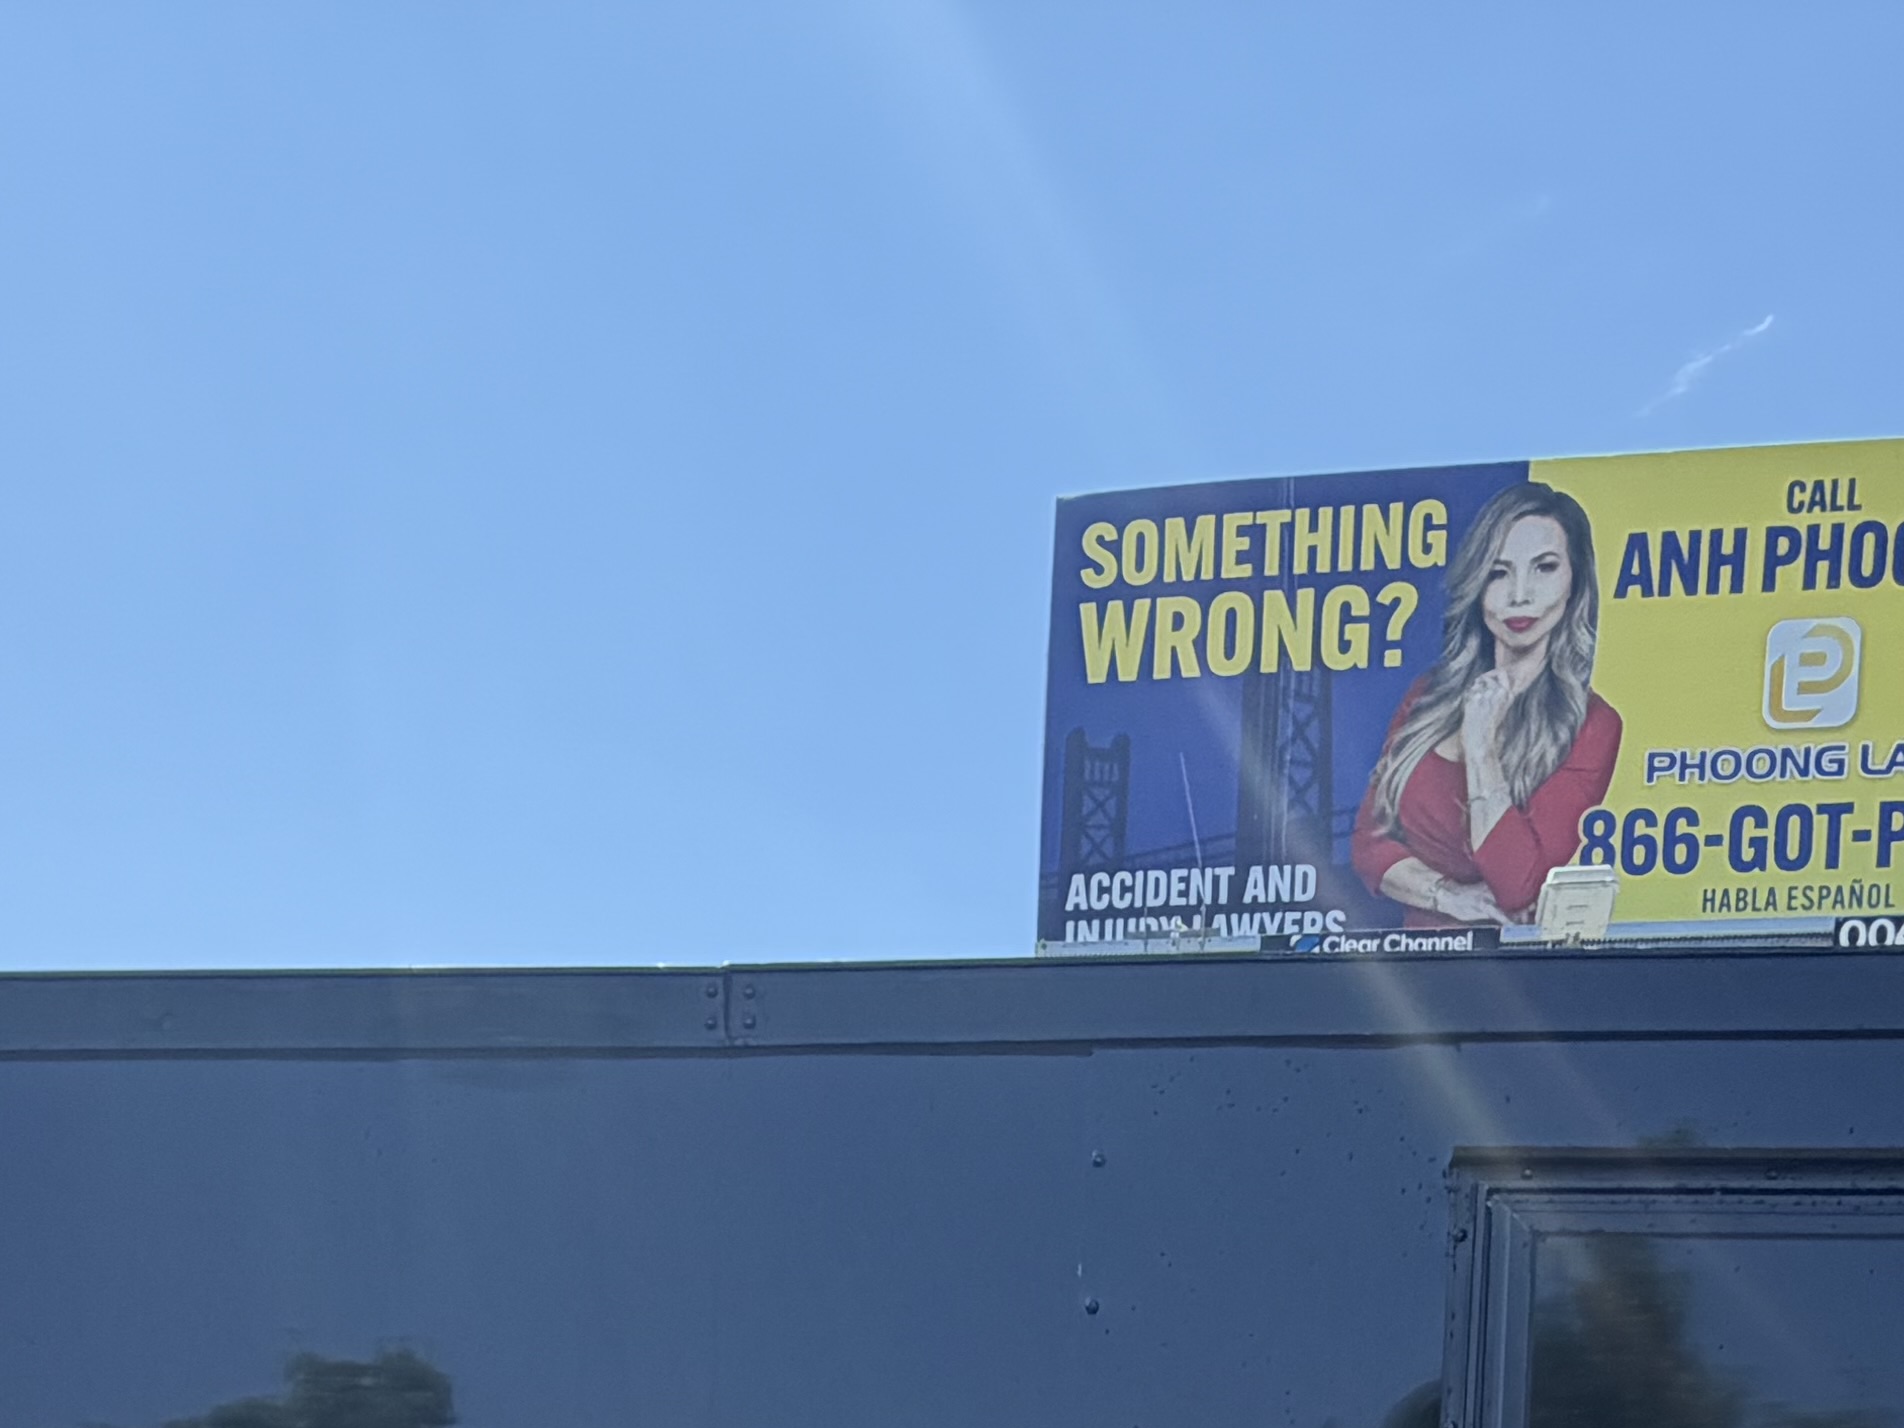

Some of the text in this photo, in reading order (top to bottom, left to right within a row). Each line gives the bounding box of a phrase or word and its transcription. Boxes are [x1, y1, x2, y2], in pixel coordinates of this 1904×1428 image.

[1786, 477, 1863, 515] CALL
[1079, 498, 1449, 589] SOMETHING
[1612, 527, 1749, 600] ANH
[1079, 581, 1419, 685] WRONG?
[1646, 743, 1847, 784] PHOONG
[1064, 863, 1318, 912] ACCIDENT AND
[1701, 878, 1896, 914] HABLA ESPAÑOL
[1323, 930, 1474, 954] Clear Channel
